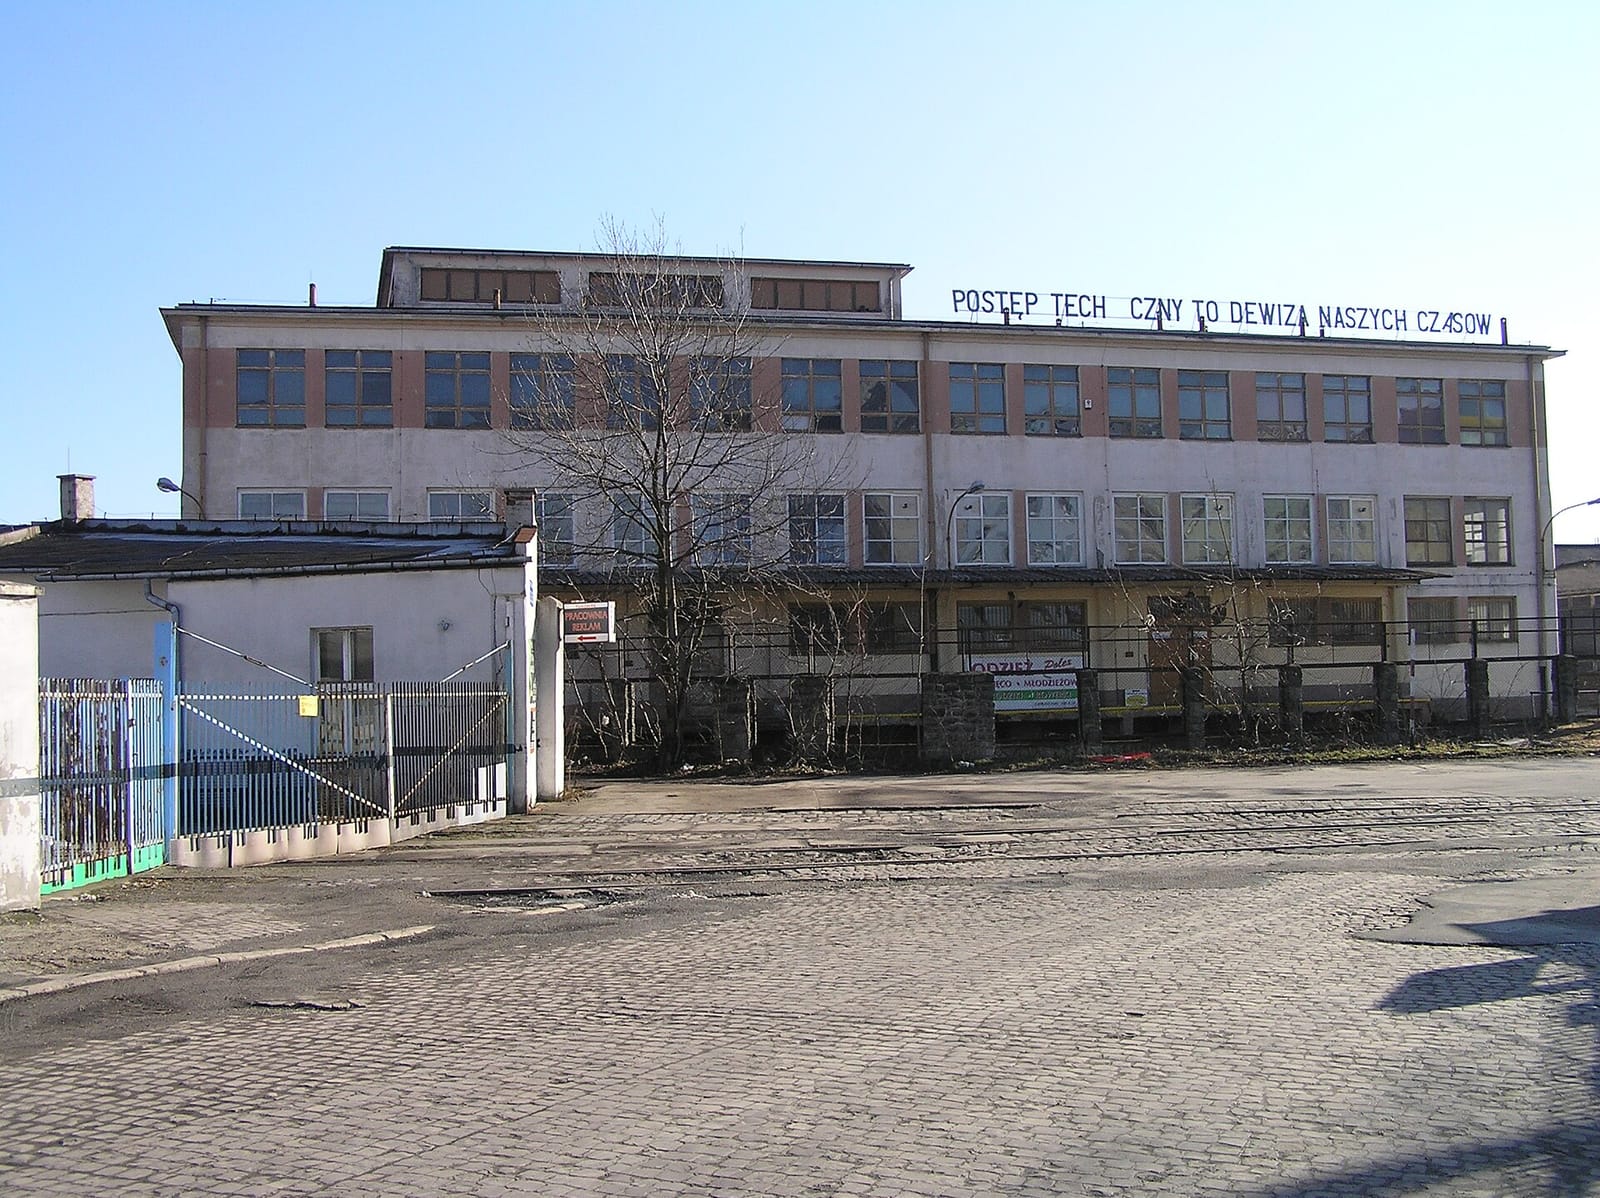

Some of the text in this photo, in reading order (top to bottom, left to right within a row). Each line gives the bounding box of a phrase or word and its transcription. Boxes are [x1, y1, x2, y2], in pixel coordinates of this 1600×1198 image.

[1051, 293, 1106, 319] TECH
[1130, 297, 1182, 321] CZNY
[1192, 299, 1219, 323] TO
[1230, 301, 1309, 327] DEWIZA
[1319, 305, 1407, 331] NASZYCH
